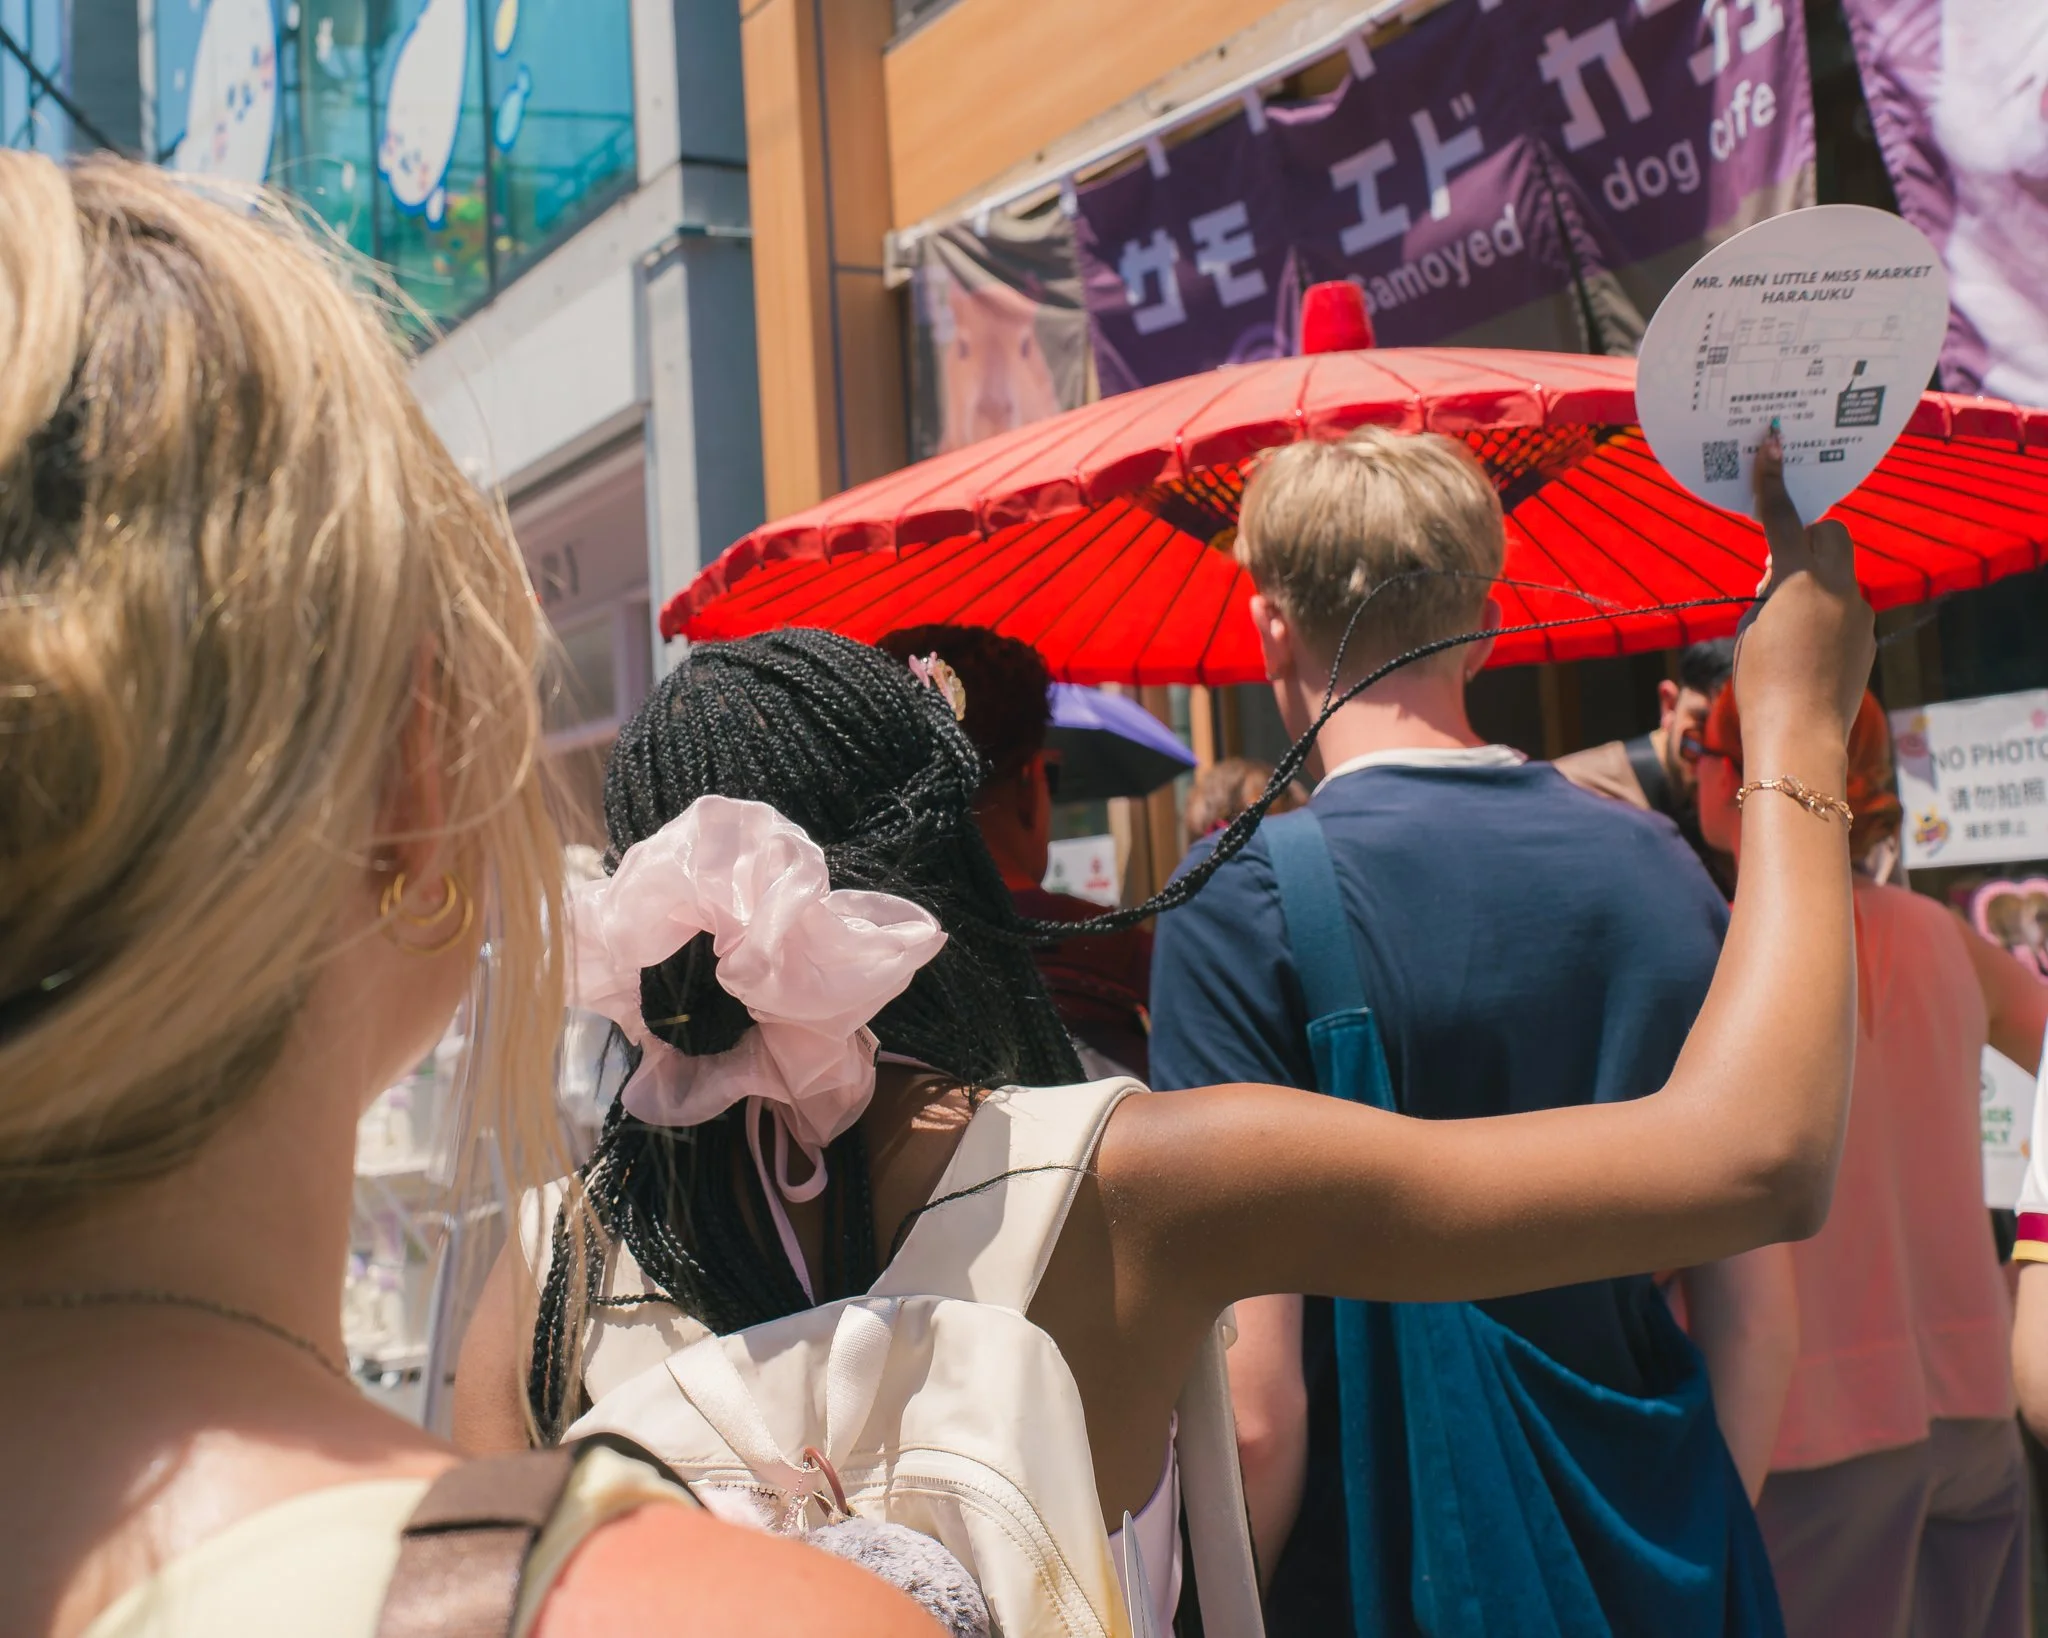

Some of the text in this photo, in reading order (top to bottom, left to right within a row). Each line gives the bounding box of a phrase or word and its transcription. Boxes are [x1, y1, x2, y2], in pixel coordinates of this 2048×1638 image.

[1602, 138, 1701, 212] dog
[1692, 265, 1934, 290] MR. MEN LITTLE MISS MARKET
[1761, 287, 1855, 304] HARAJUKU
